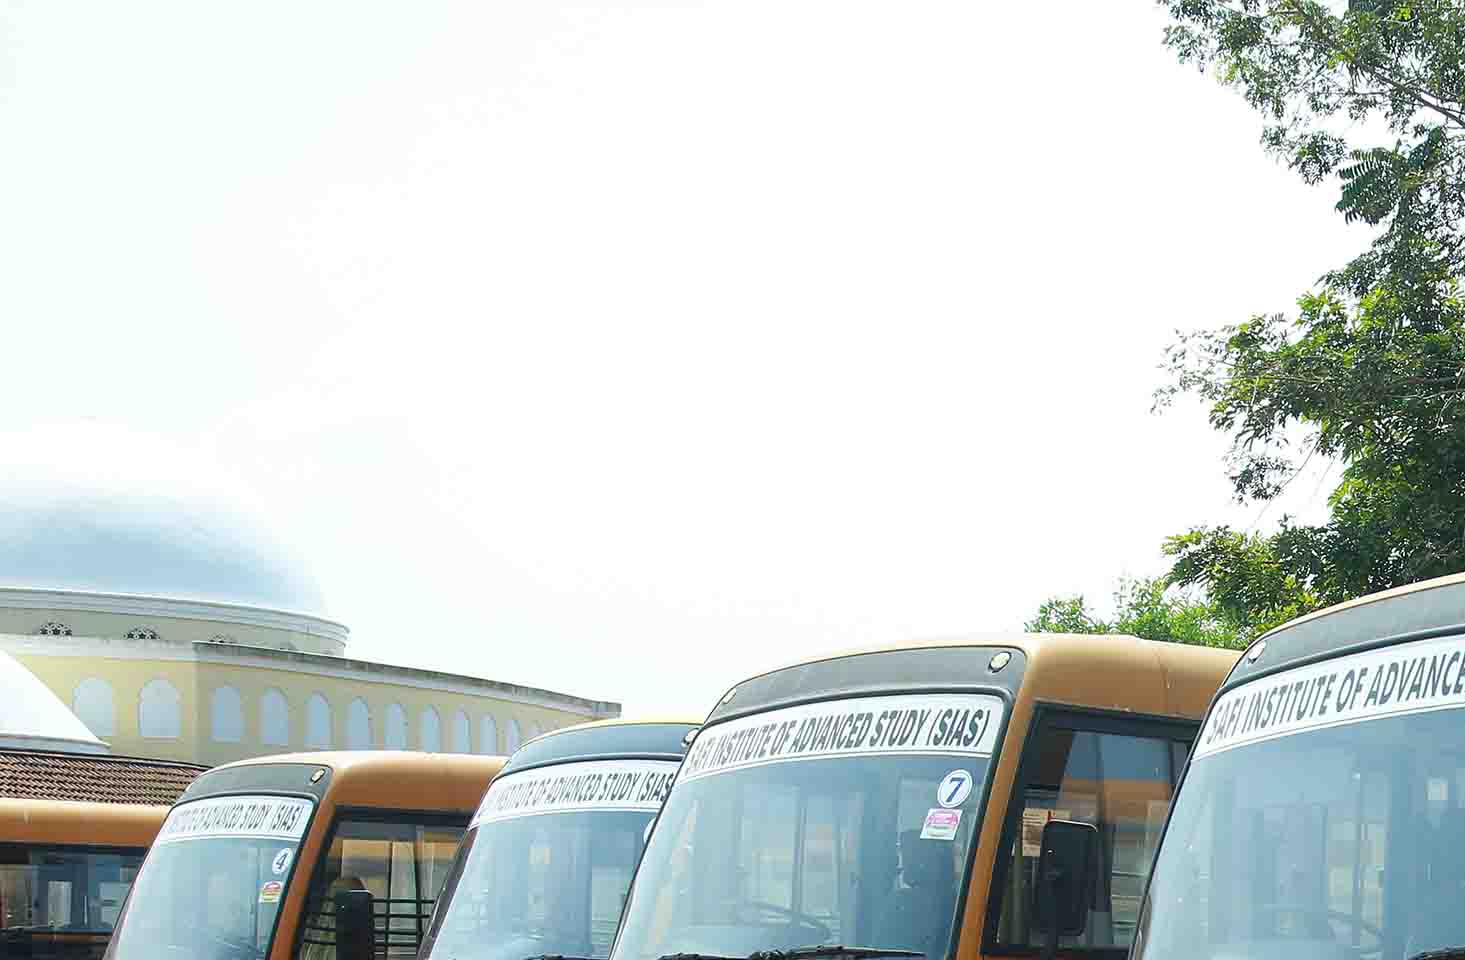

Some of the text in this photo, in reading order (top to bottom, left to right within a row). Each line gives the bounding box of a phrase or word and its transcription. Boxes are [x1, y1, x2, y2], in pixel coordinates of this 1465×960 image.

[1206, 696, 1246, 745] SAFI
[1241, 673, 1337, 735] INSTITUTE
[1336, 667, 1369, 713] OF
[708, 723, 778, 769] INSTITUTE
[769, 719, 798, 756] OF
[790, 712, 874, 753] ADVANCED
[869, 709, 931, 747] STUDY
[925, 709, 991, 747] (SIAS)
[546, 774, 603, 804] ADVANCED
[600, 772, 643, 802] STUDY
[945, 777, 966, 803] 7
[239, 803, 272, 829] STUDY
[271, 804, 304, 833] (SIAS)
[275, 852, 288, 870] 4
